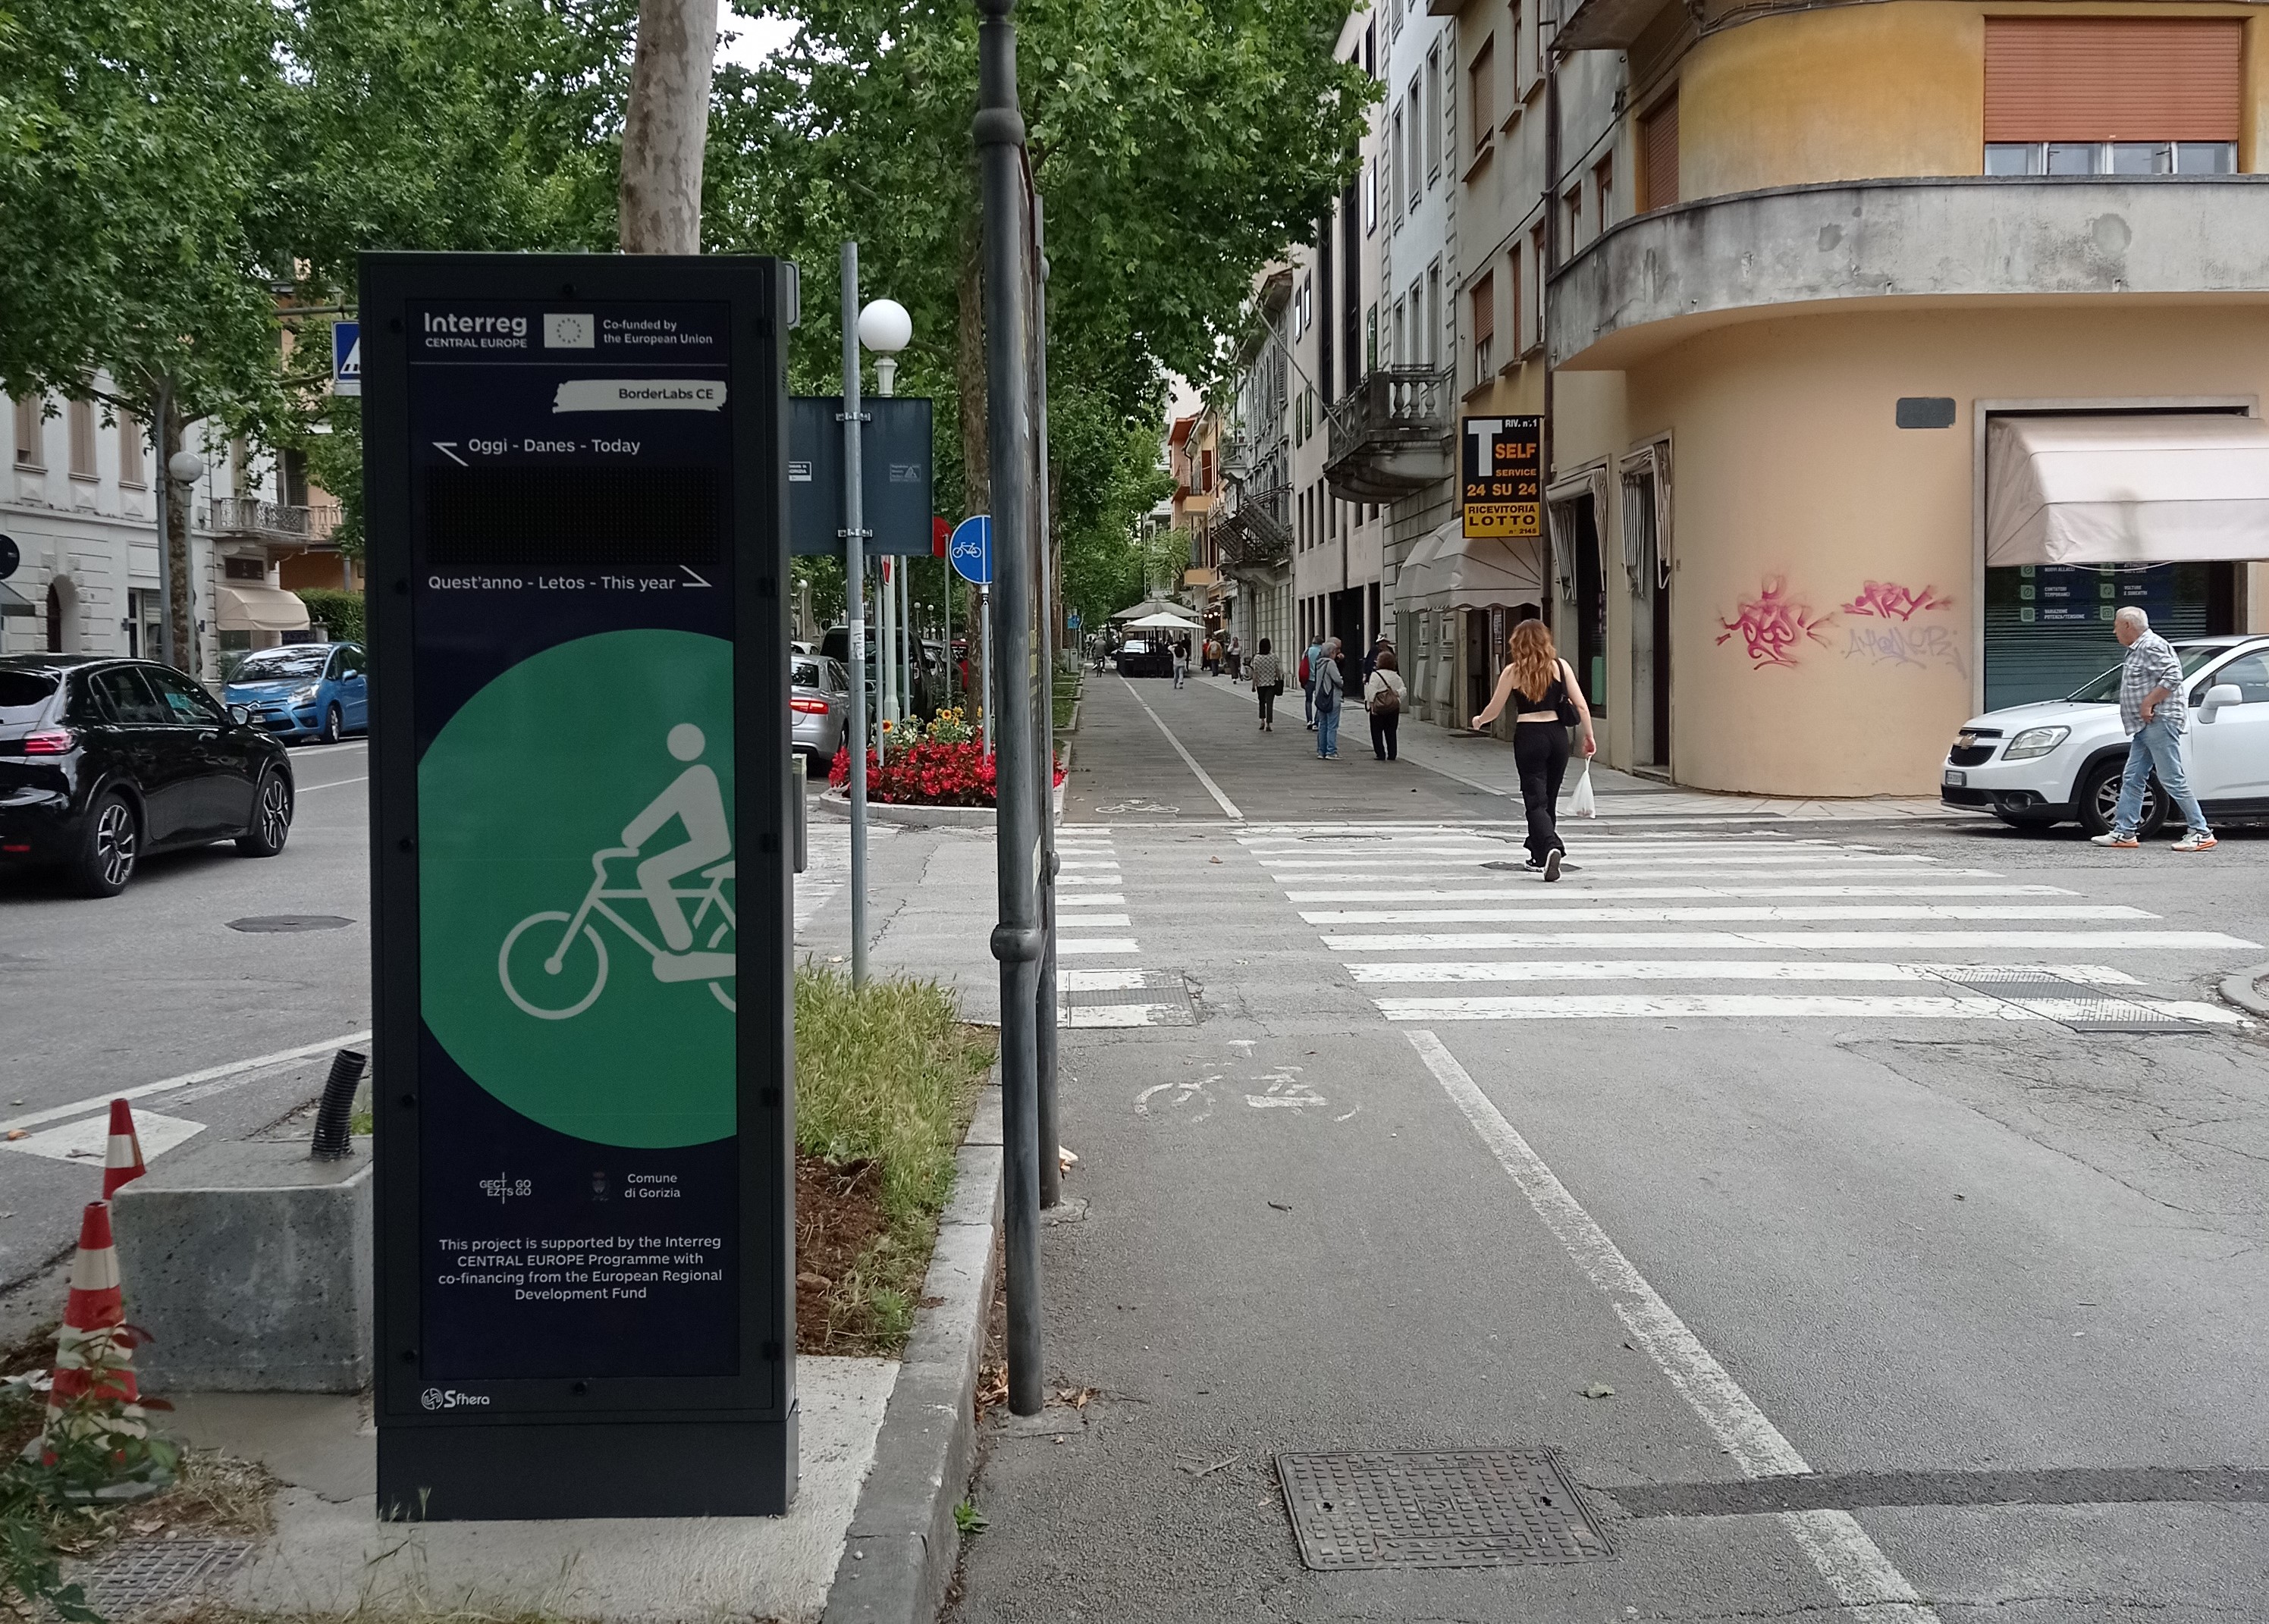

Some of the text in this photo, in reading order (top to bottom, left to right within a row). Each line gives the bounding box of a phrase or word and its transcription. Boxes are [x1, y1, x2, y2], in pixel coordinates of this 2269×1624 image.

[424, 312, 527, 335] Interreg
[603, 319, 677, 332] Co-funded by
[425, 337, 527, 348] CENTRAL EUROPE
[604, 334, 713, 346] the European Union
[618, 387, 714, 400] BorderLabs CE
[1505, 419, 1521, 428] RIV.
[468, 437, 508, 455] Oggi
[524, 438, 576, 453] Danes
[592, 438, 641, 455] Today
[1468, 419, 1502, 477] T
[1495, 443, 1536, 459] SELF
[1495, 468, 1536, 477] SERVICE
[1467, 483, 1537, 496] 24 SU 24
[1468, 505, 1535, 514] RICEVITORIA
[1469, 515, 1536, 526] LOTTO
[428, 575, 523, 590] Quest'anno
[539, 576, 585, 589] Letos
[601, 575, 635, 589] This
[639, 578, 676, 592] year
[479, 1180, 507, 1189] GECT
[515, 1179, 532, 1189] GO
[627, 1173, 678, 1184] Comune
[487, 1188, 513, 1197] EZTS
[515, 1188, 532, 1197] GO
[624, 1187, 681, 1198] di Gorizia
[438, 1235, 721, 1252] This project is supported by the Interreg
[457, 1252, 703, 1268] CENTRAL EUROPE Programme with
[438, 1268, 722, 1286] co-financing from the European Regional
[515, 1287, 647, 1302] Development Fund
[444, 1390, 490, 1408] Sfhera
